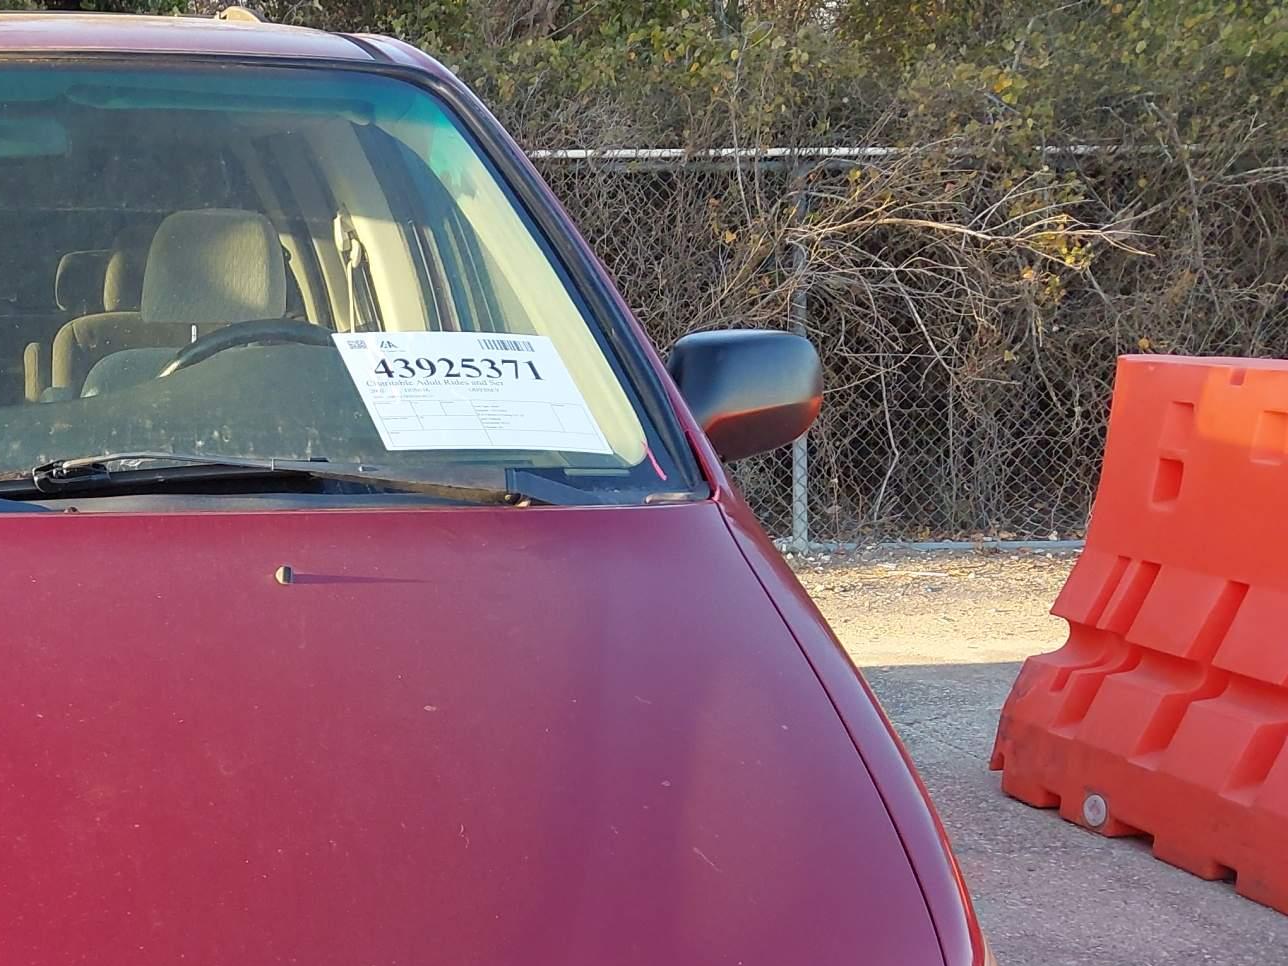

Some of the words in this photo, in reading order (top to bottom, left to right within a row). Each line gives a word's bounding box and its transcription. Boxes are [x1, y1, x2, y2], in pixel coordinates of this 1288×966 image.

[374, 357, 544, 381] 43925371
[416, 378, 441, 386] Adult
[443, 378, 470, 386] Rides
[471, 378, 488, 386] and
